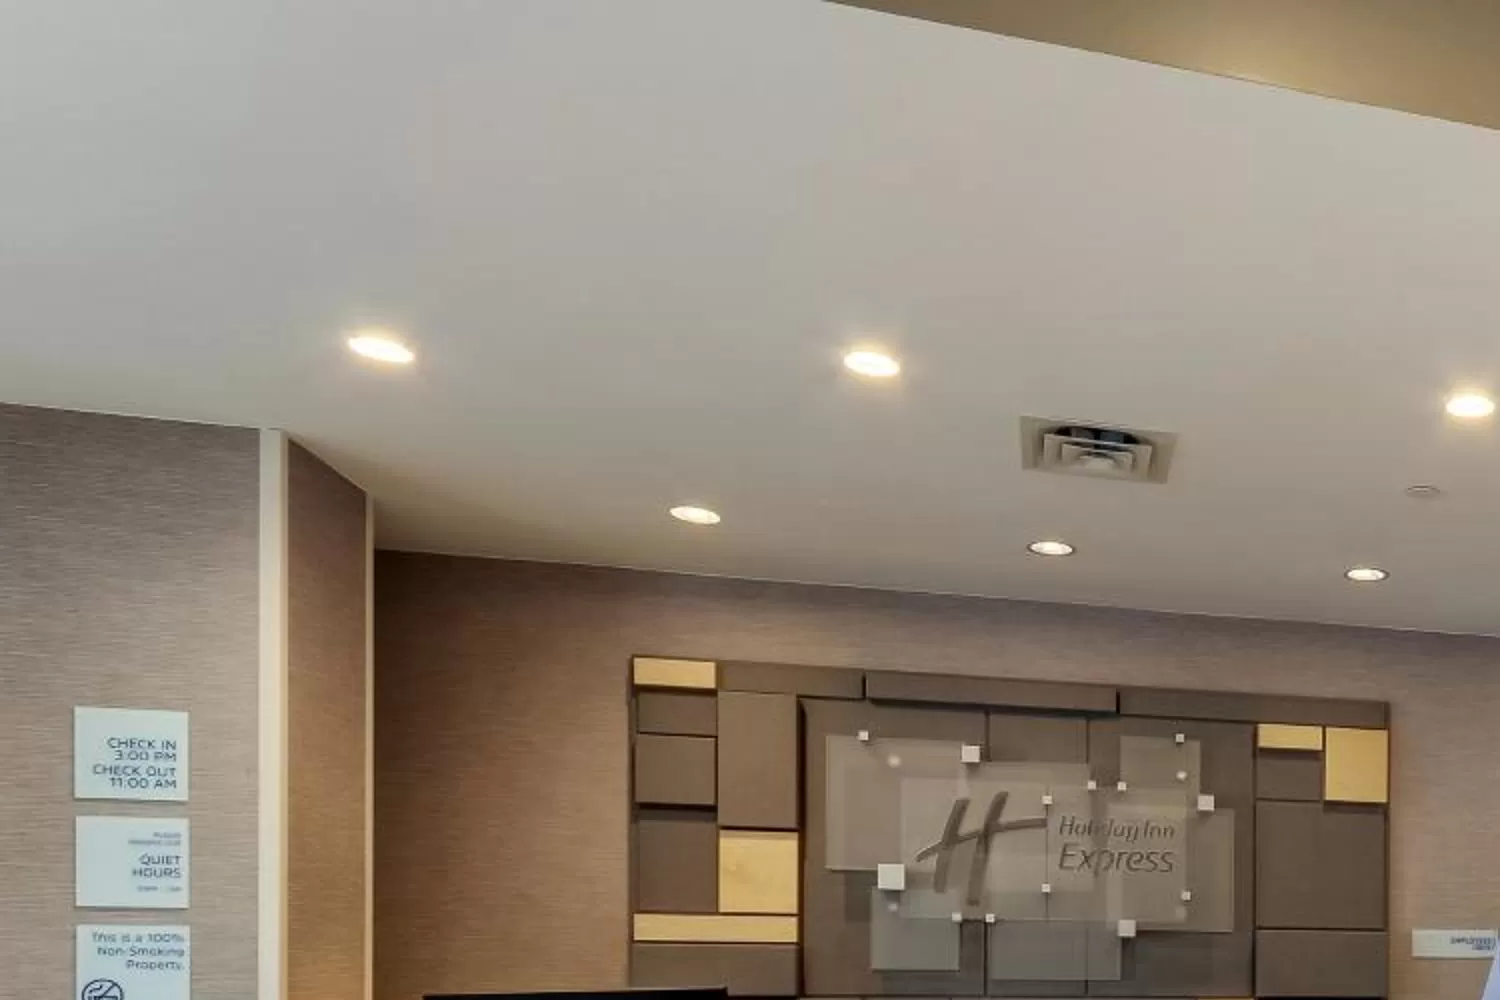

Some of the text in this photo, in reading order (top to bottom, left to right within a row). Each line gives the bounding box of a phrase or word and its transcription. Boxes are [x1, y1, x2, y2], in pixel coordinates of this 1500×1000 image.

[107, 737, 177, 750] CHECK IN
[114, 750, 177, 762] 3:00 PM
[92, 763, 177, 777] CHECK OUT
[108, 777, 177, 789] 11:00 AM
[1143, 819, 1176, 839] Inn
[139, 852, 184, 866] QUIET
[1058, 843, 1174, 878] Express
[132, 867, 182, 879] HOURS
[91, 931, 117, 943] This
[121, 933, 131, 943] is
